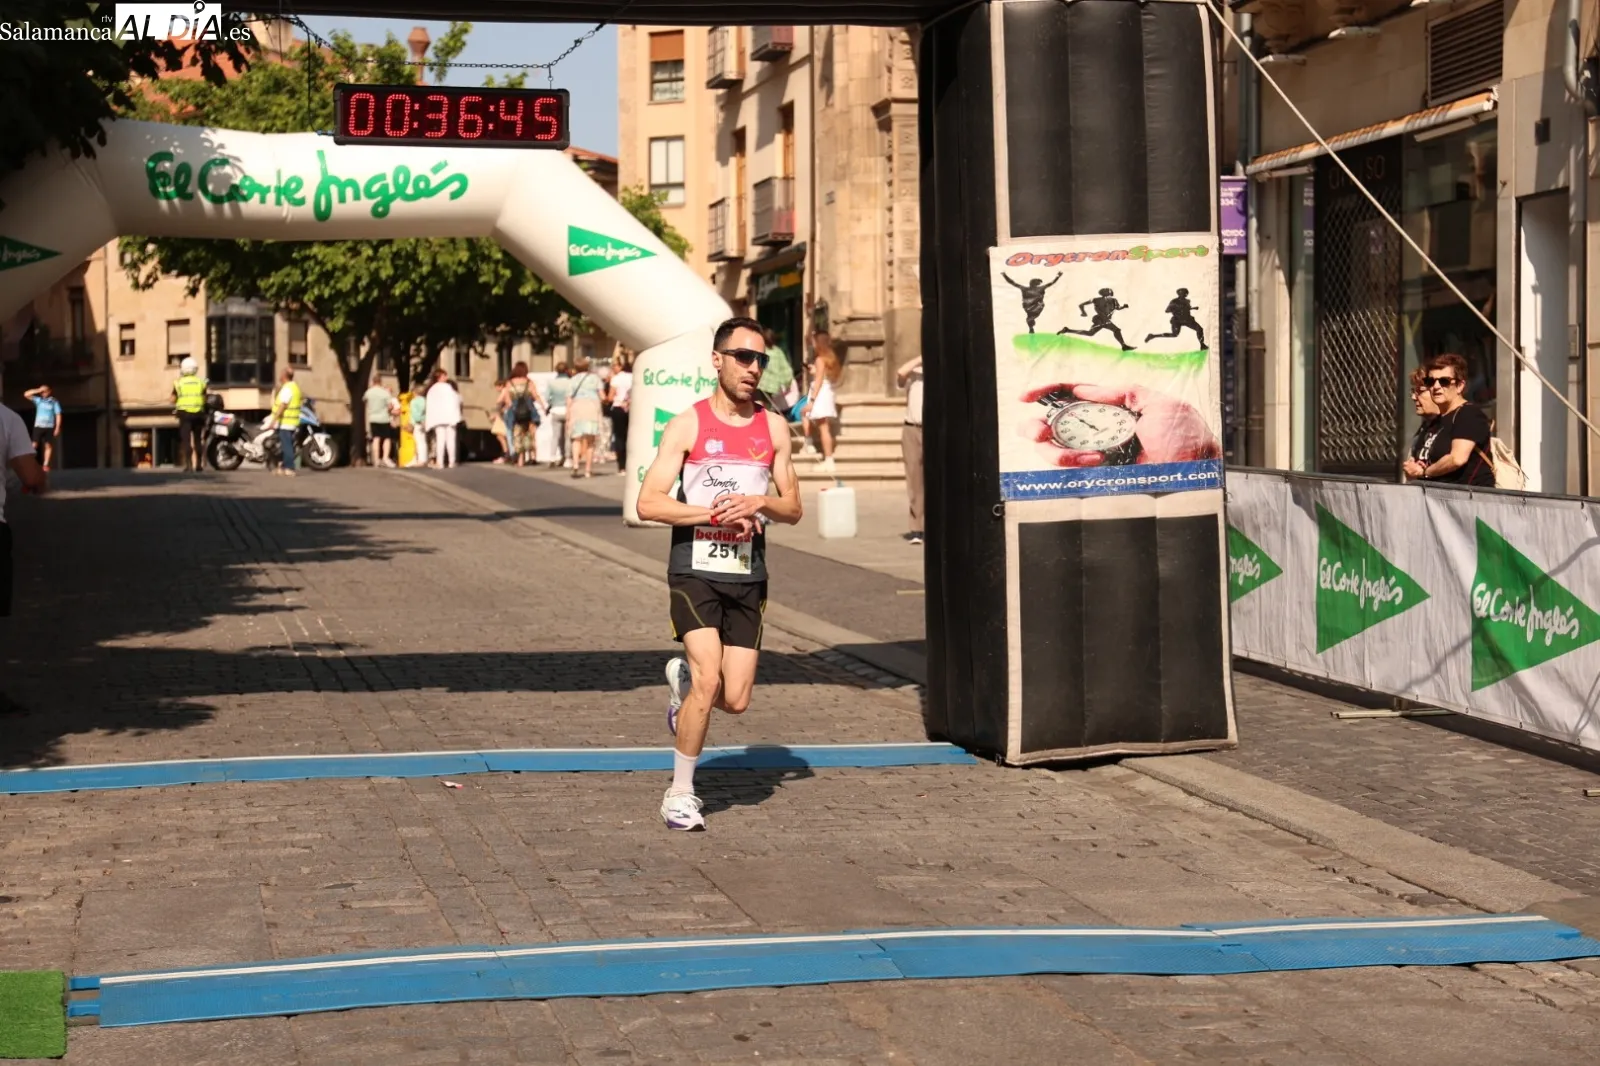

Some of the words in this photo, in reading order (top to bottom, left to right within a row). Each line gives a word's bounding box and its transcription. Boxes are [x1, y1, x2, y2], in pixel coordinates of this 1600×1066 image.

[349, 92, 558, 140] 00:36:45
[146, 151, 194, 201] El
[198, 158, 306, 206] Corte
[569, 244, 580, 256] El
[643, 368, 654, 386] El
[656, 369, 692, 386] Corte
[702, 465, 740, 491] Simón
[1017, 472, 1219, 491] www.orycronsport.com
[708, 543, 739, 559] 251
[1229, 553, 1261, 586] nglés
[1319, 557, 1333, 590] El
[1332, 561, 1359, 596] Corte
[1473, 582, 1491, 619] El
[1489, 587, 1526, 627] Corte
